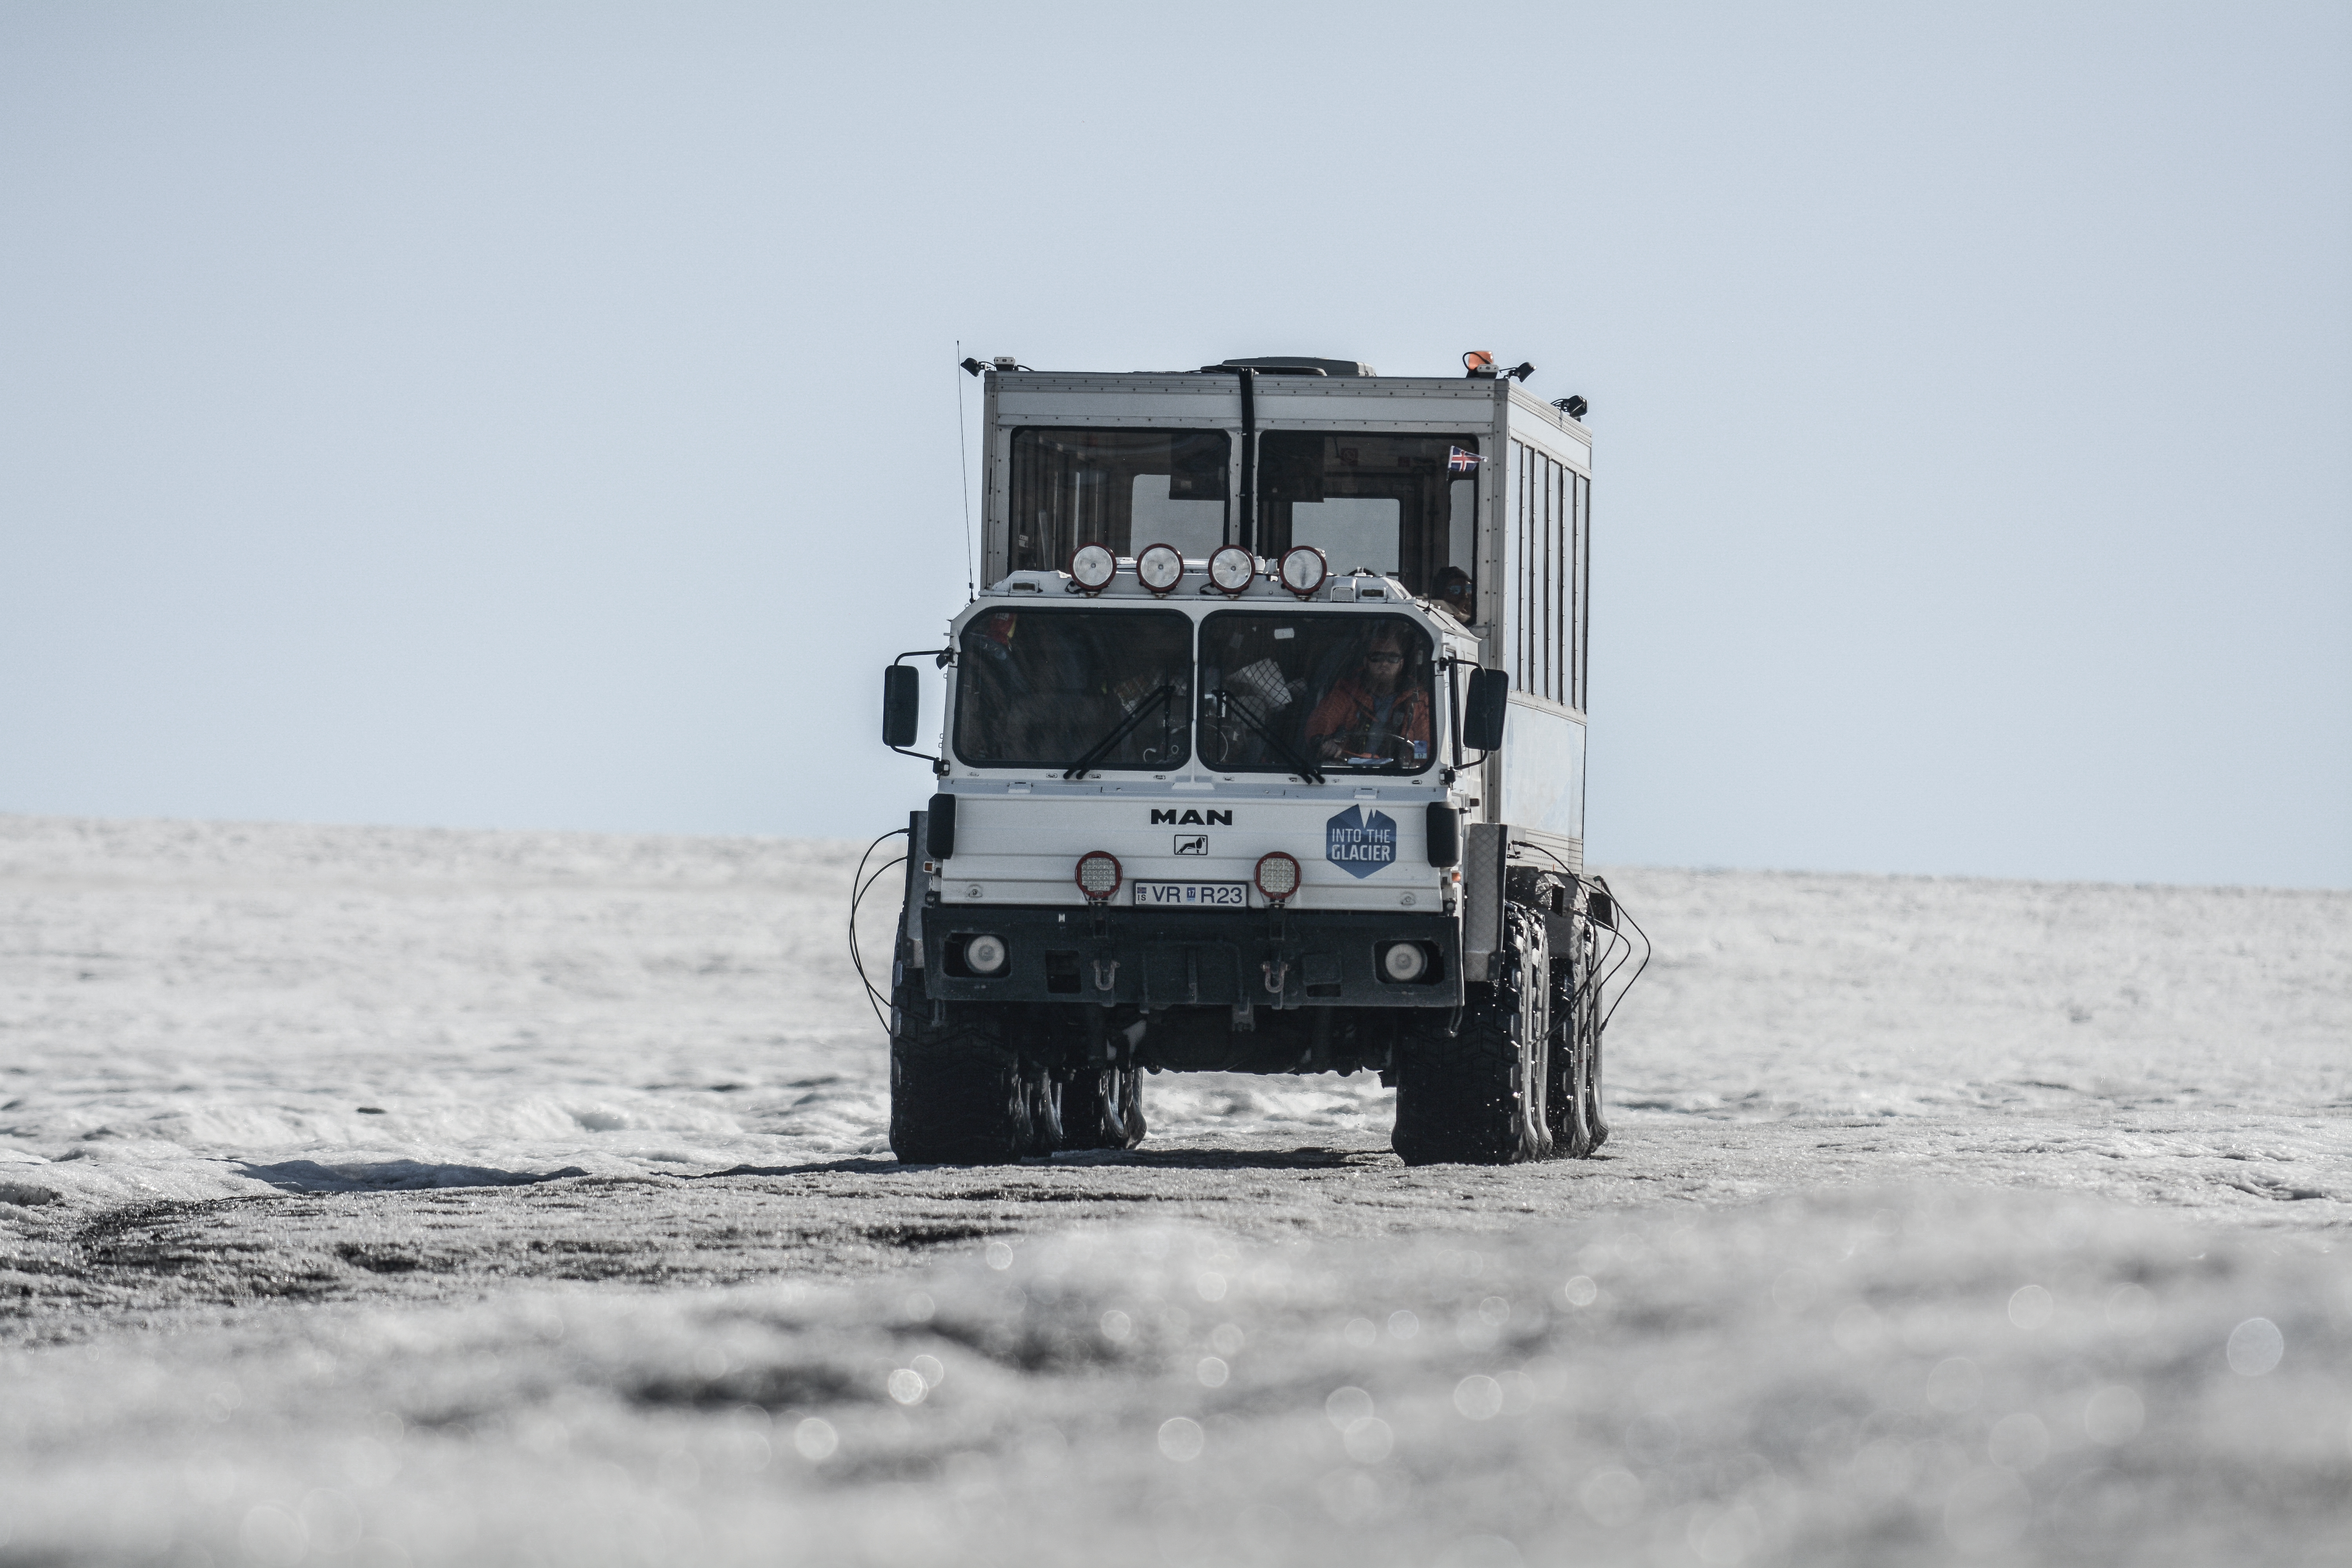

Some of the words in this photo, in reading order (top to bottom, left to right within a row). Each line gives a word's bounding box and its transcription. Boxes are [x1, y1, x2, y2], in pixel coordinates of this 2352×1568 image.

[1151, 809, 1232, 826] MAN
[1332, 828, 1361, 842] INTO
[1367, 829, 1390, 843] THE
[1332, 844, 1390, 861] GLACIER
[1152, 886, 1181, 902] VR
[1201, 887, 1243, 904] R23
